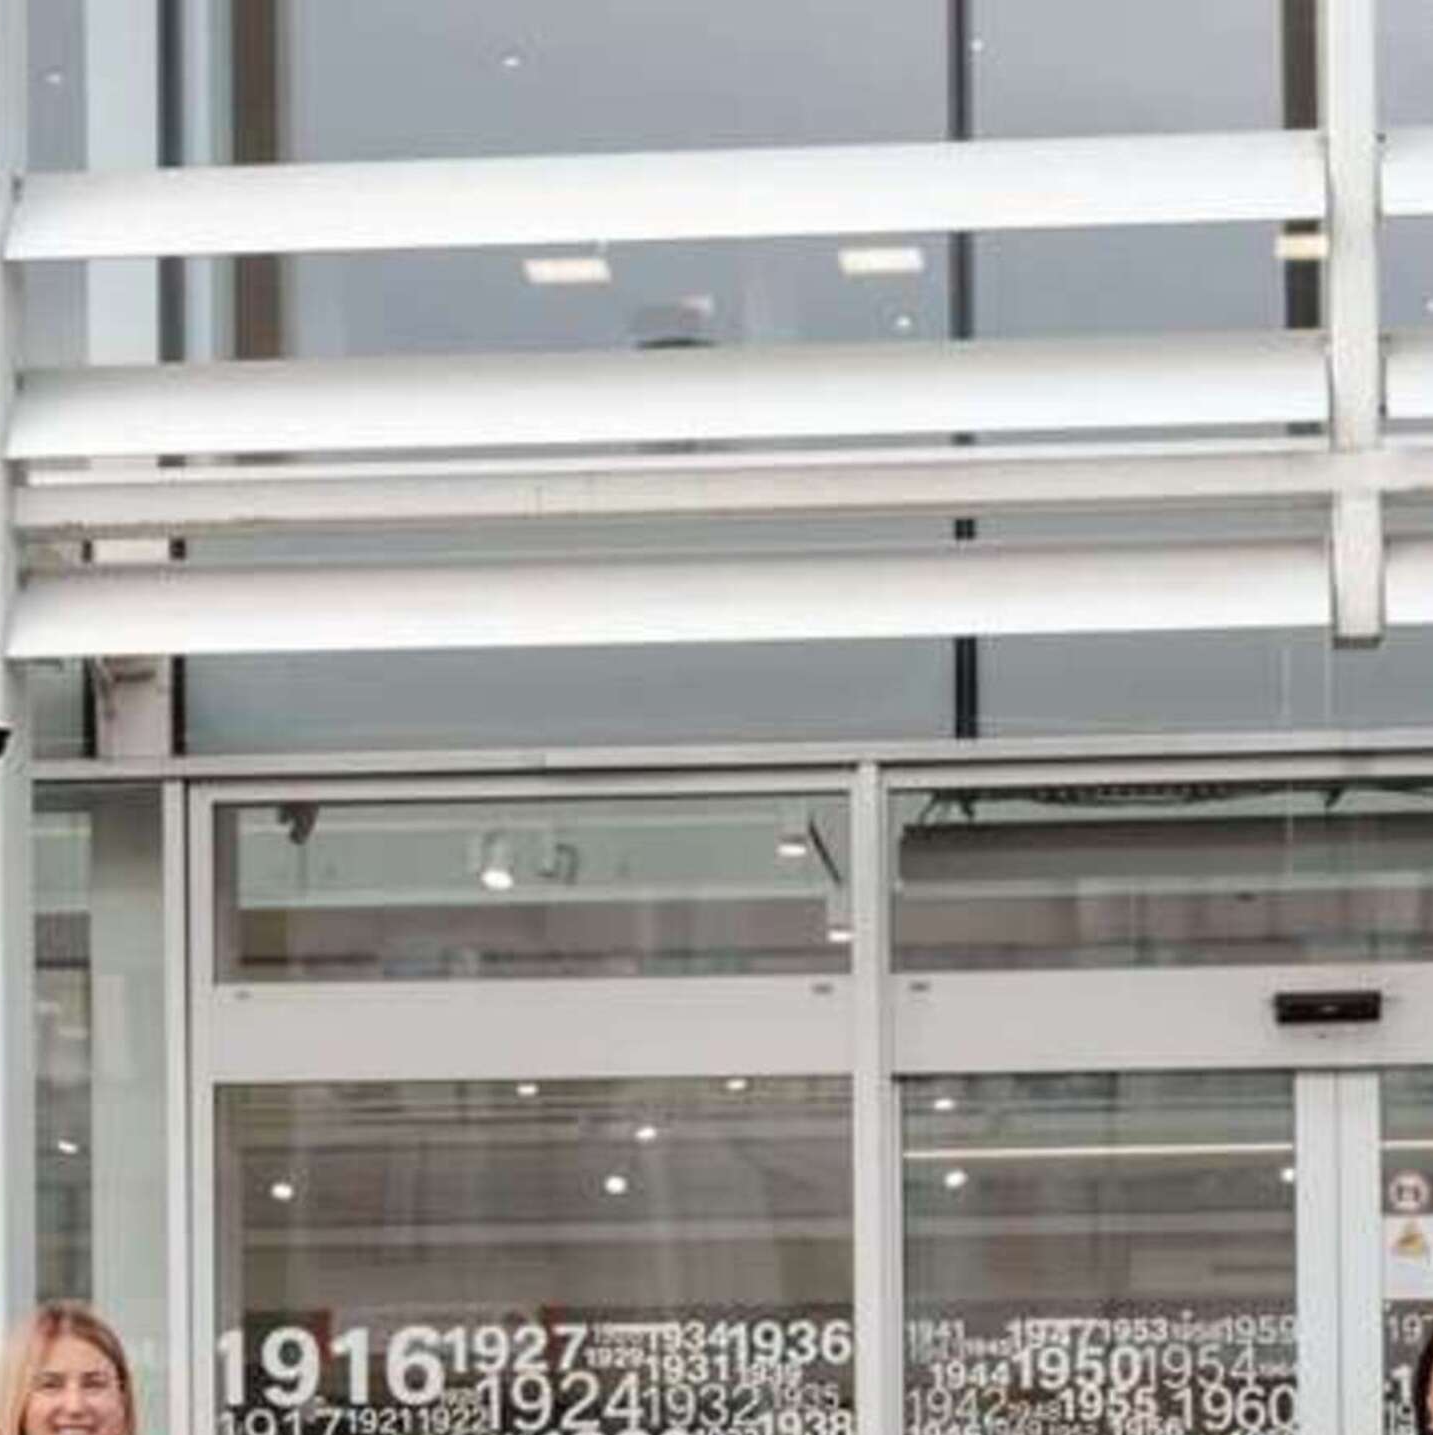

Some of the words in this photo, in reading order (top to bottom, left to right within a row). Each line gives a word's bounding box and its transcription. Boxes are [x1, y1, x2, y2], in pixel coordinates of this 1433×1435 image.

[443, 1325, 587, 1373] 1927
[647, 1319, 729, 1350] 1934
[727, 1319, 852, 1365] 1936
[219, 1326, 446, 1406] 1916
[647, 1353, 729, 1383] 1931
[929, 1359, 1011, 1391] 1944
[1011, 1345, 1140, 1391] 1950
[1143, 1339, 1257, 1390] 1954
[346, 1406, 413, 1435] 1921
[477, 1370, 644, 1432] 1924
[643, 1383, 762, 1429] 1932
[1058, 1383, 1159, 1422] 1955
[1171, 1383, 1298, 1432] 1960
